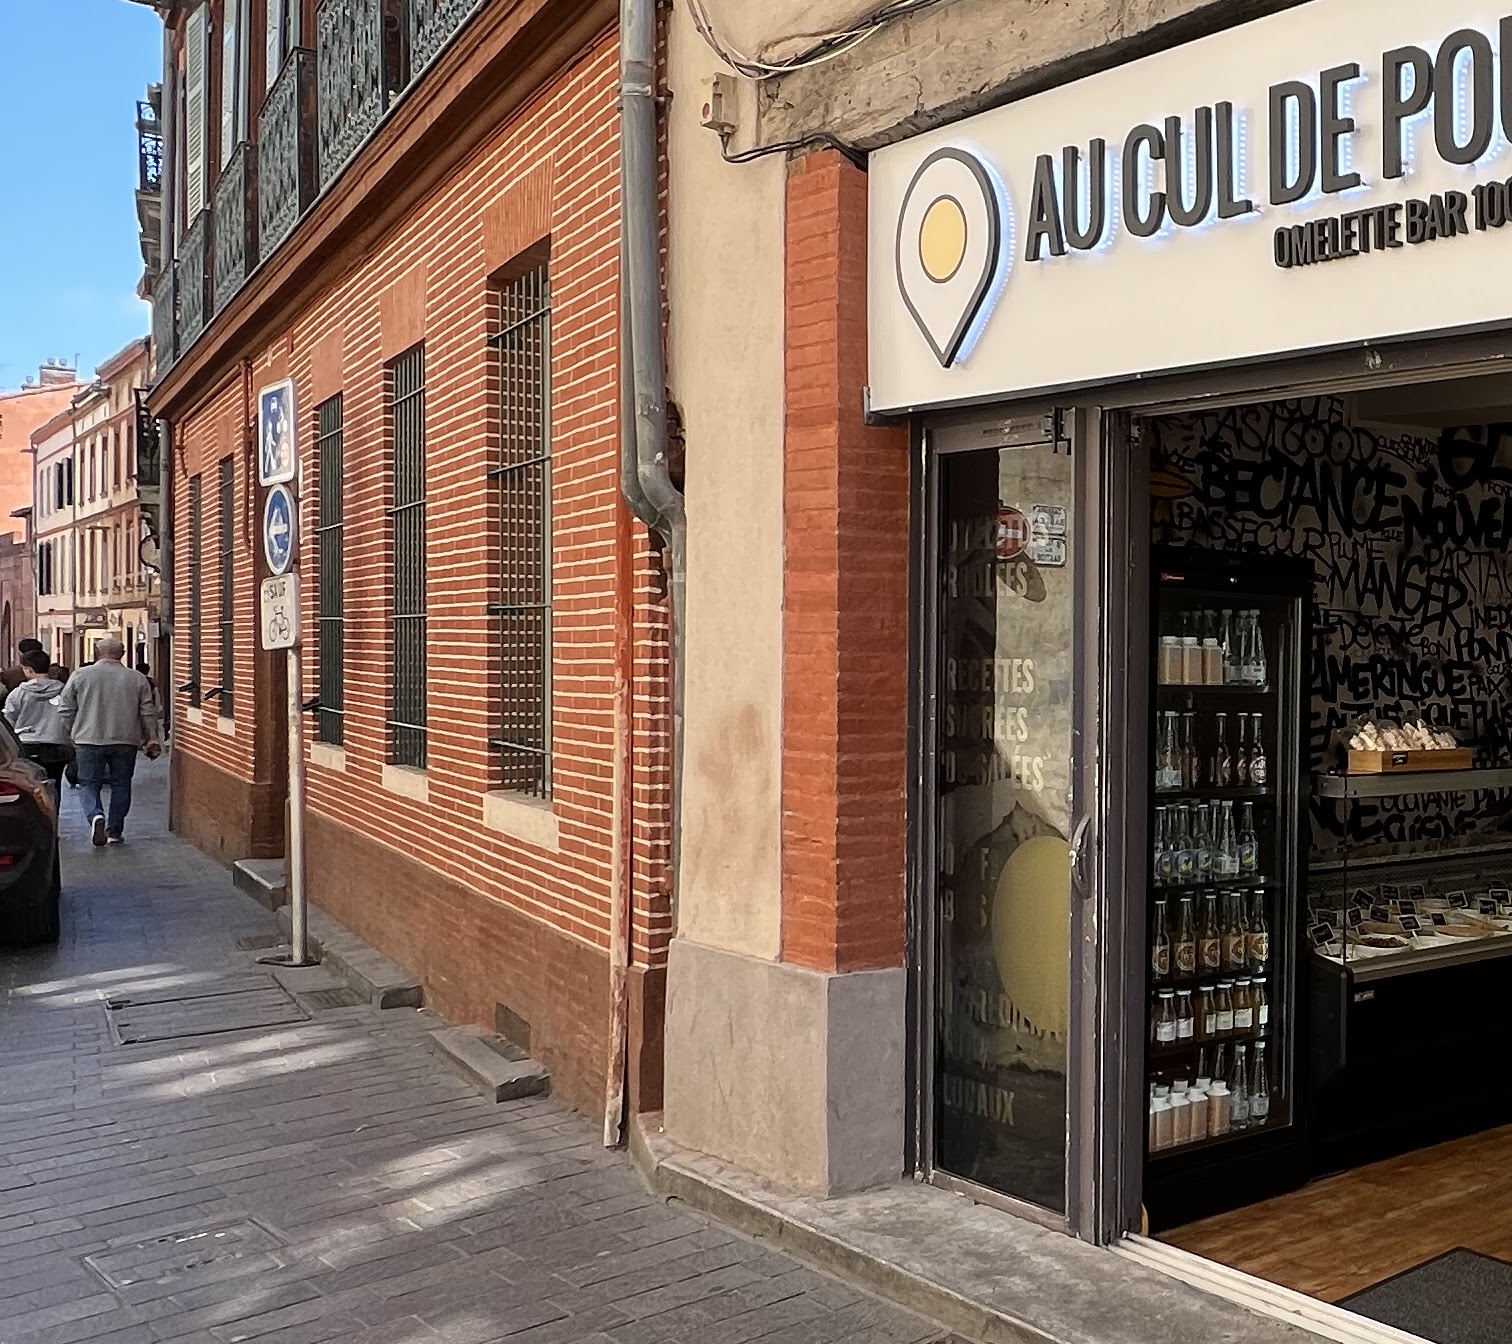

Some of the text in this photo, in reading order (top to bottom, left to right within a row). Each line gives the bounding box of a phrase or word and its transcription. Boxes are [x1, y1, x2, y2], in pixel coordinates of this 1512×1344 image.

[1026, 137, 1105, 262] AU
[1122, 101, 1253, 239] CUL
[1268, 62, 1361, 206] DE
[1273, 201, 1403, 269] OMELETTE
[1407, 192, 1468, 244] BAR
[1326, 553, 1470, 638] MANGER
